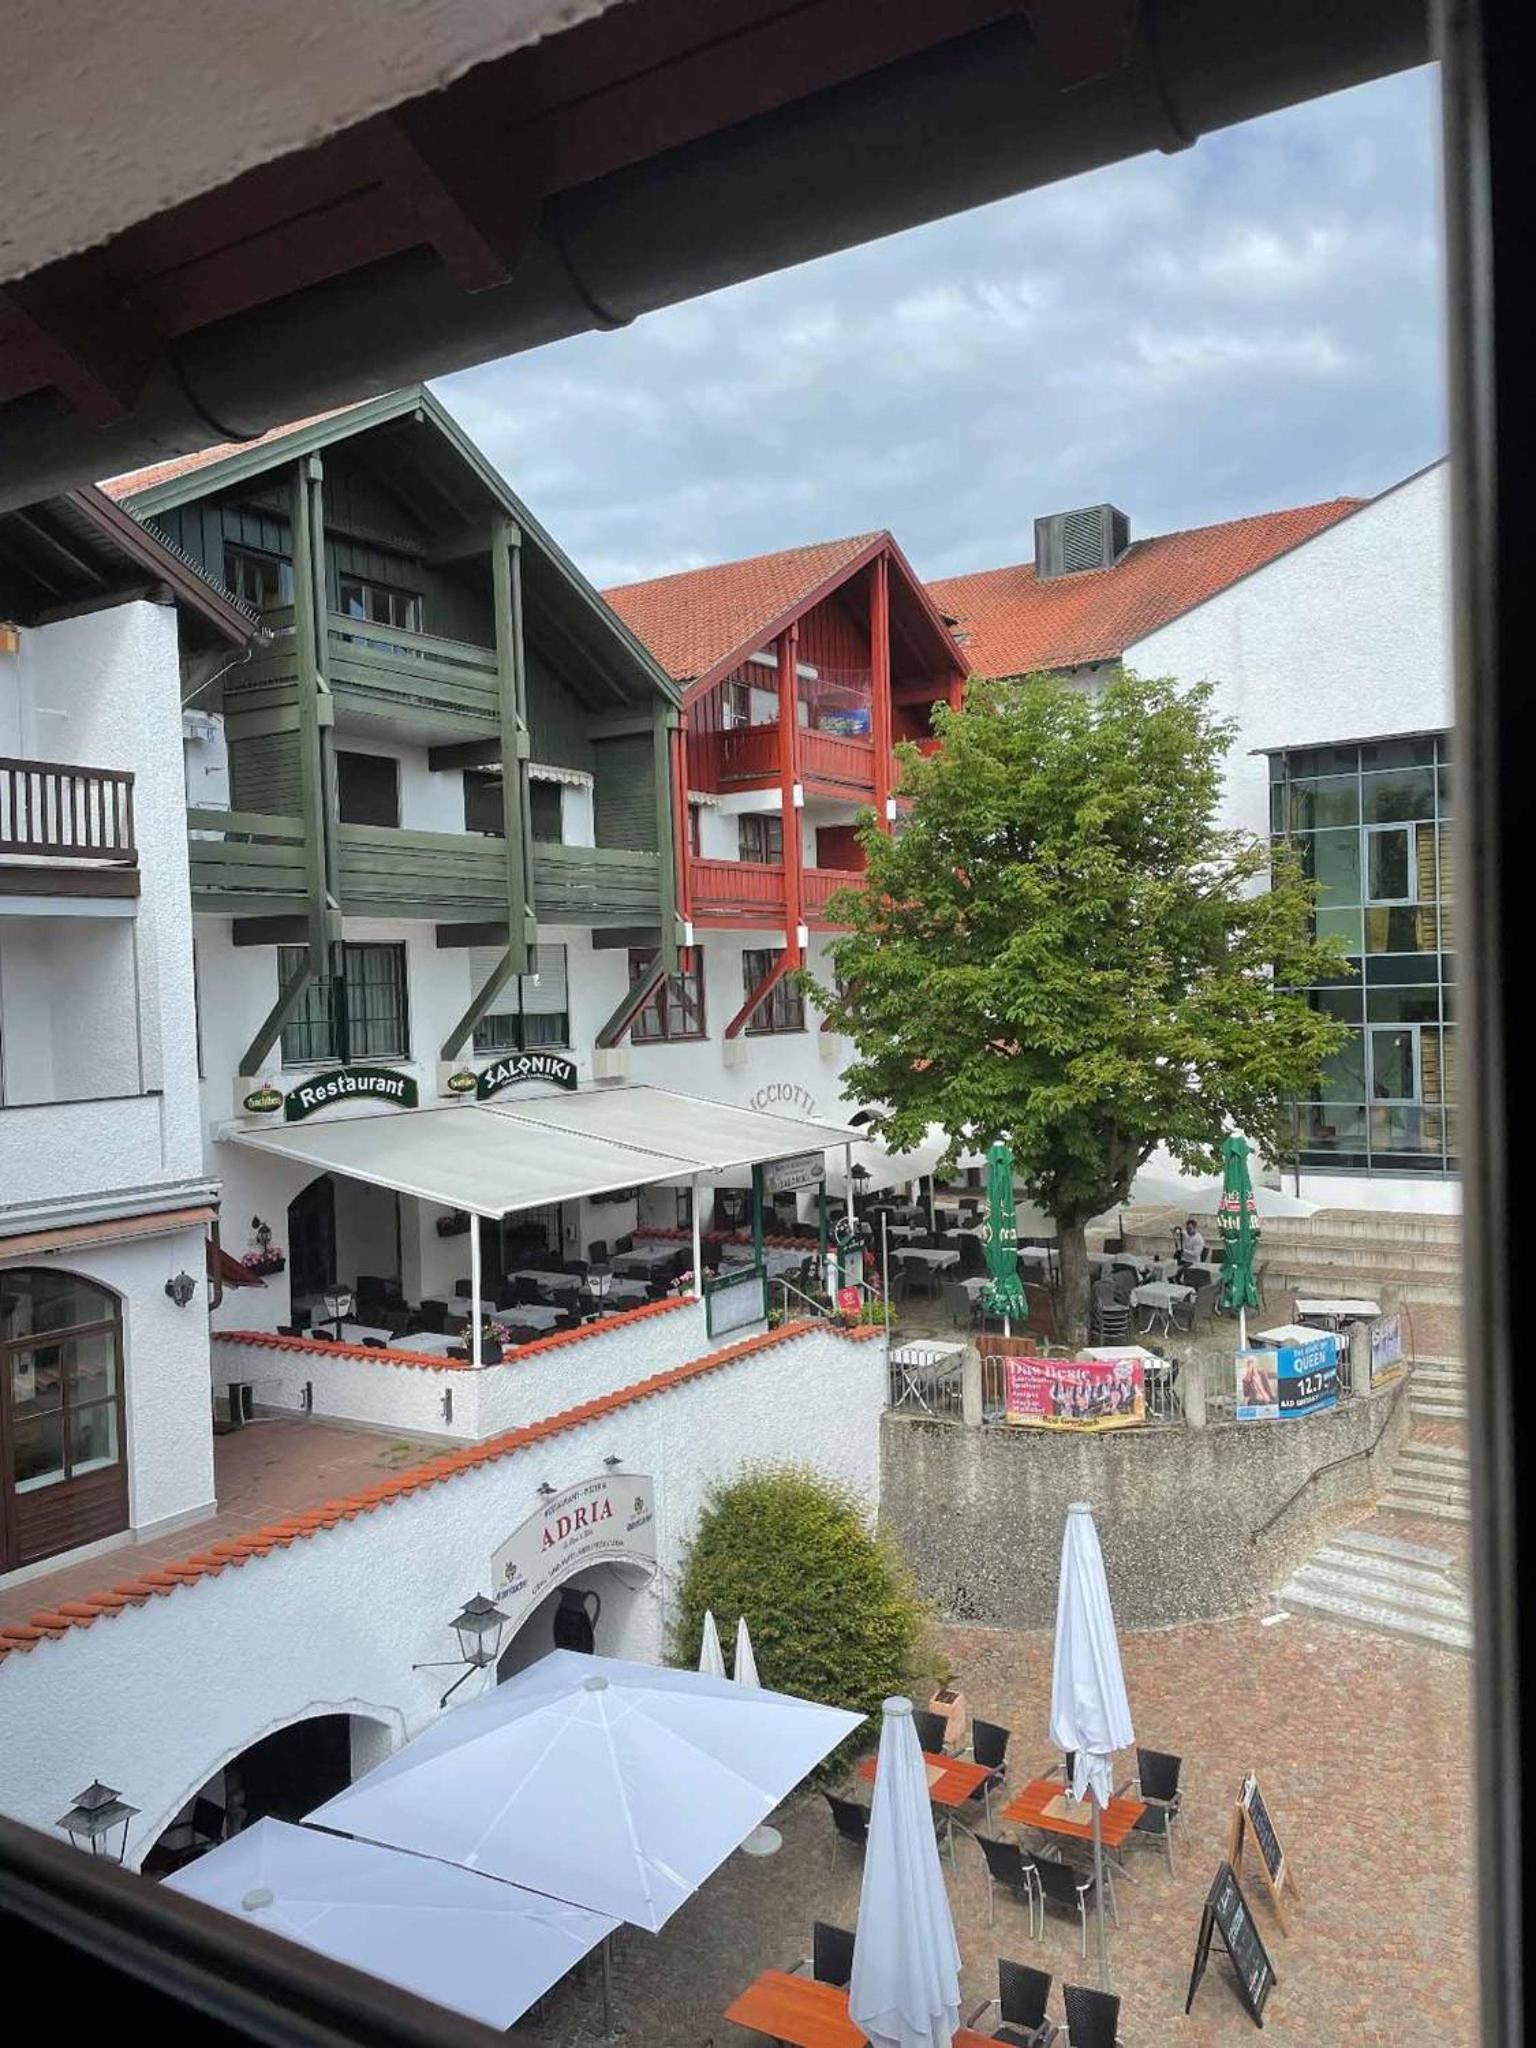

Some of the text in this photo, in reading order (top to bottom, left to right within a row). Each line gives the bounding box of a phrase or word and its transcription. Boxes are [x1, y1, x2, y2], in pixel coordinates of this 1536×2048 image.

[485, 1056, 571, 1089] SALONIKI
[301, 1074, 405, 1109] Restaurant
[1293, 1351, 1326, 1373] QUEEN
[541, 1498, 613, 1552] ADRIA
